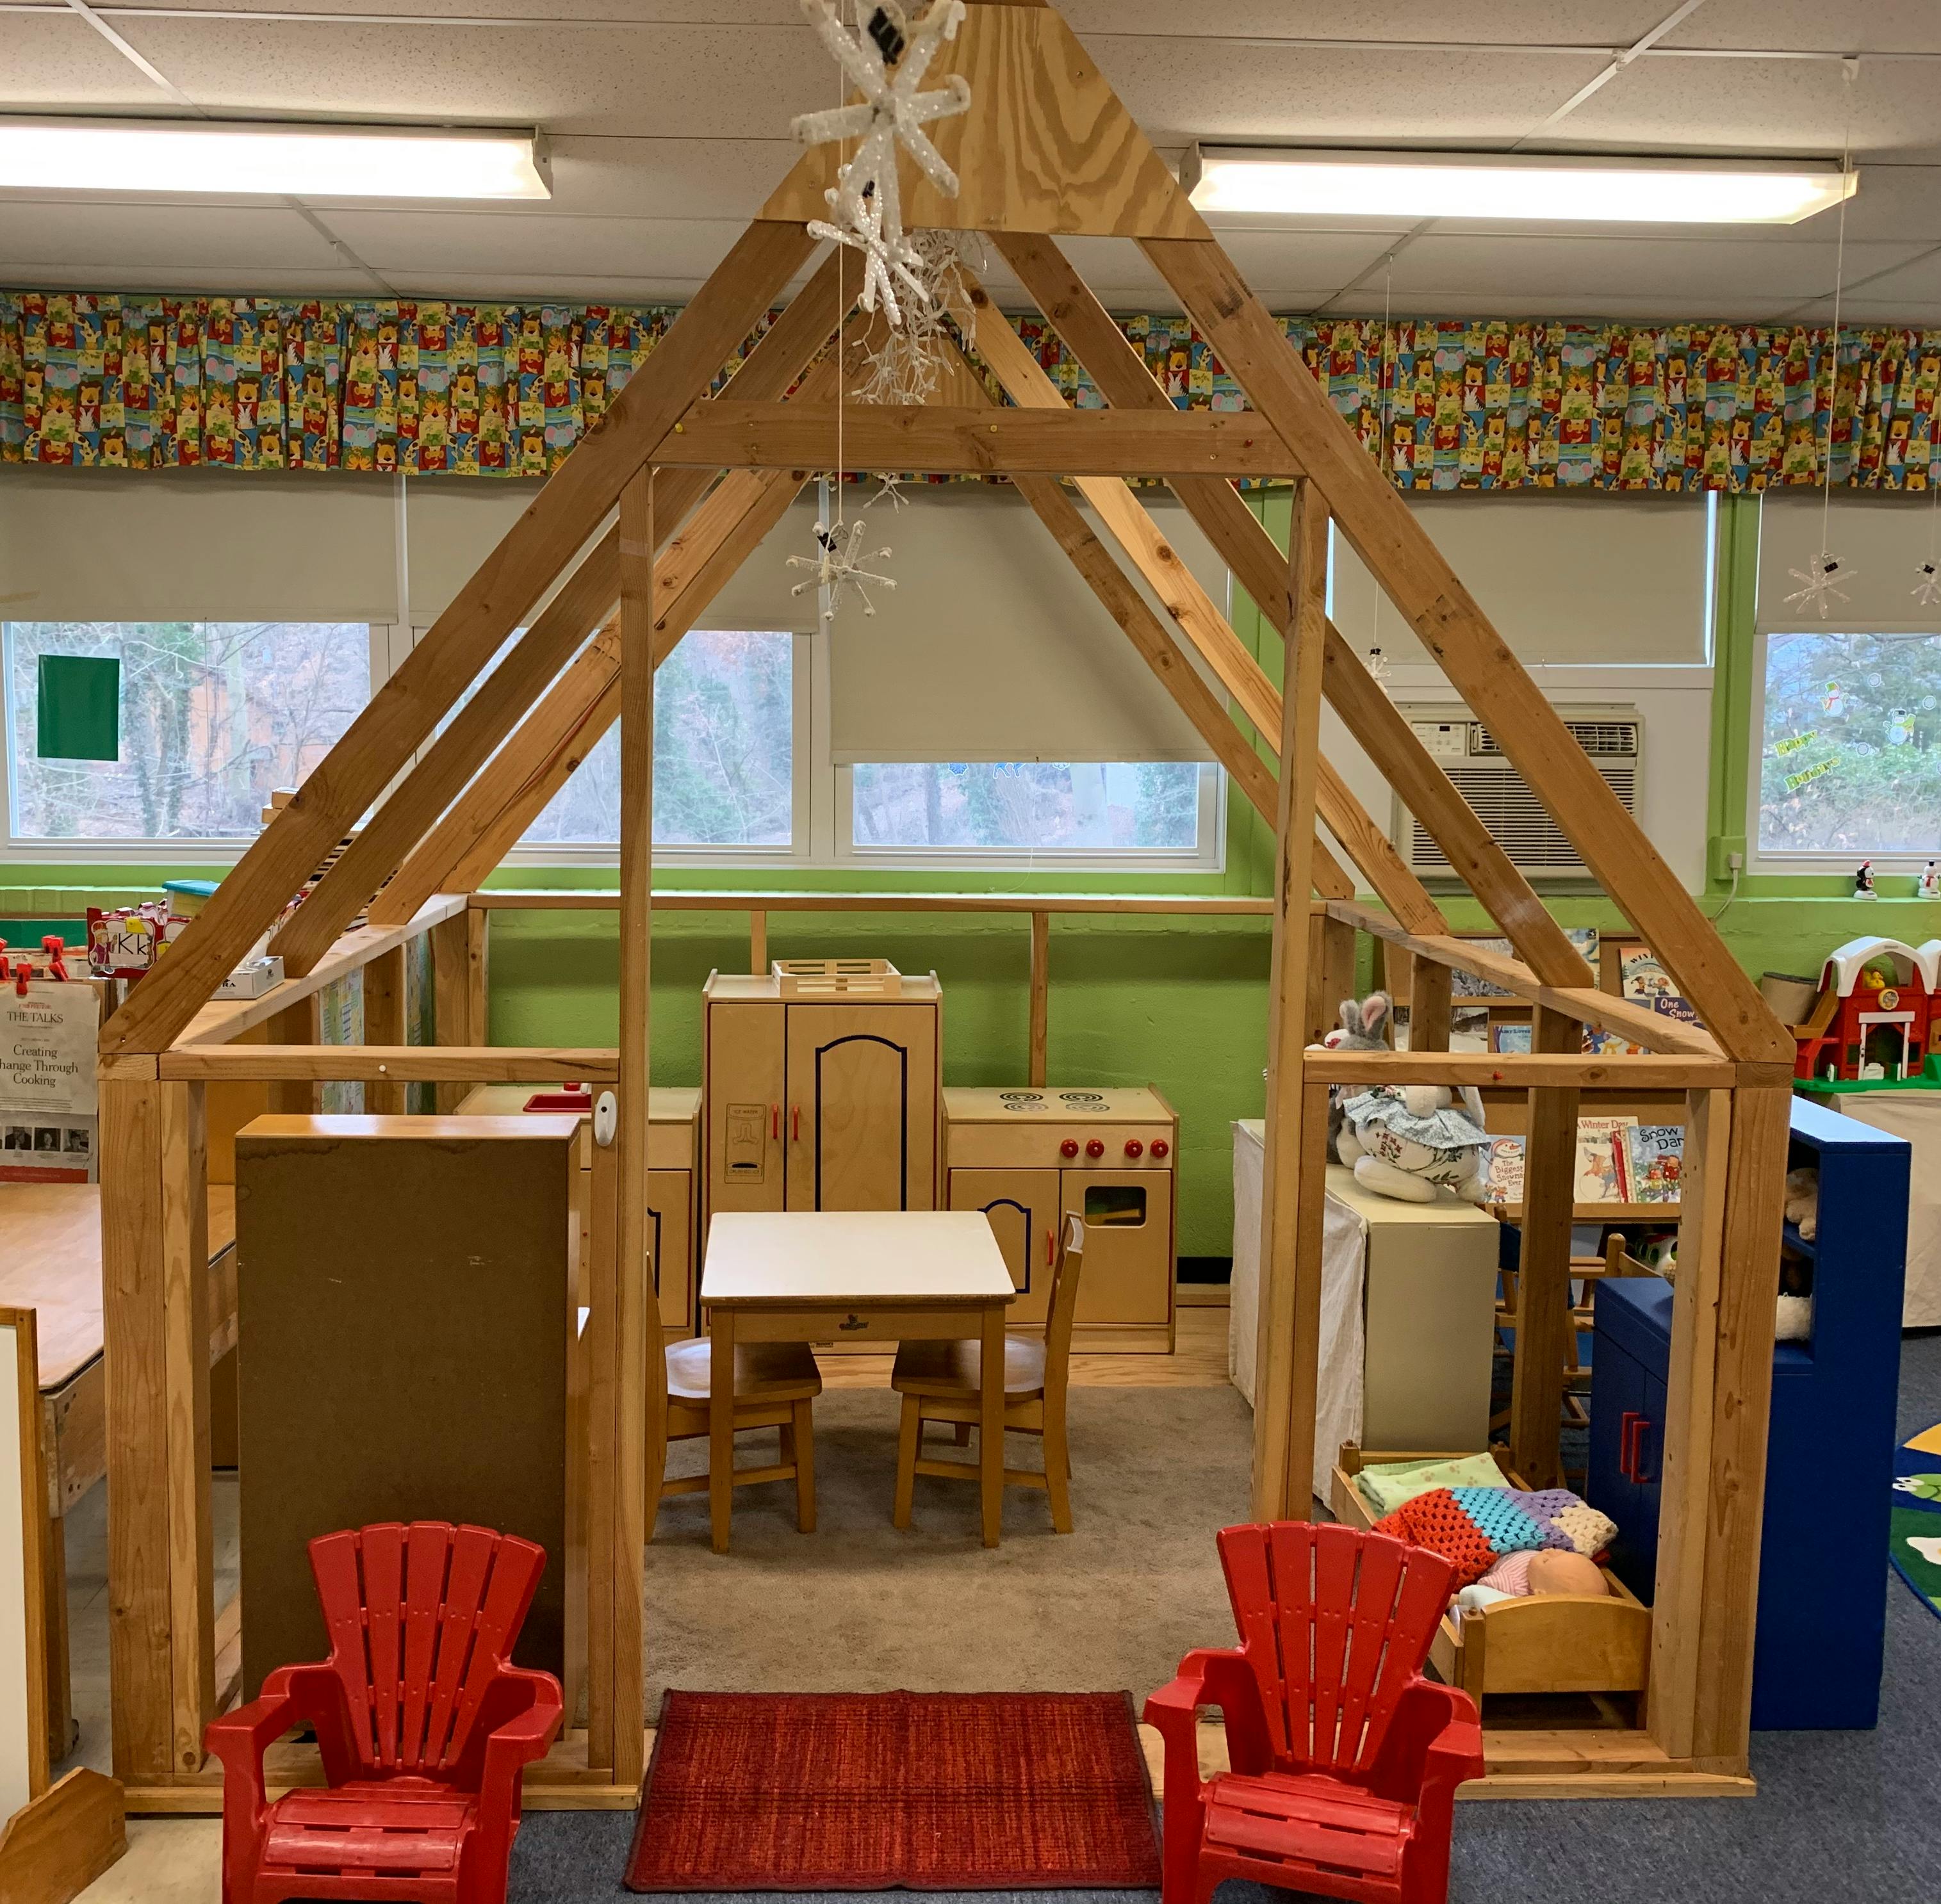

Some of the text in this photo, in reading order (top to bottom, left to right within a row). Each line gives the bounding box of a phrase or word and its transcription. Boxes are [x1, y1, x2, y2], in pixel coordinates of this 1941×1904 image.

[1660, 998, 1679, 1009] One
[7, 1011, 63, 1023] THE TALKS
[1669, 1009, 1696, 1020] Snow
[13, 1045, 58, 1060] Creating
[0, 1059, 78, 1076] hange Through
[13, 1073, 56, 1088] Cooking
[1582, 1120, 1609, 1129] Winter
[1640, 1127, 1678, 1143] Snow
[1495, 1166, 1523, 1175] Biggest
[1496, 1173, 1524, 1183] Snowma
